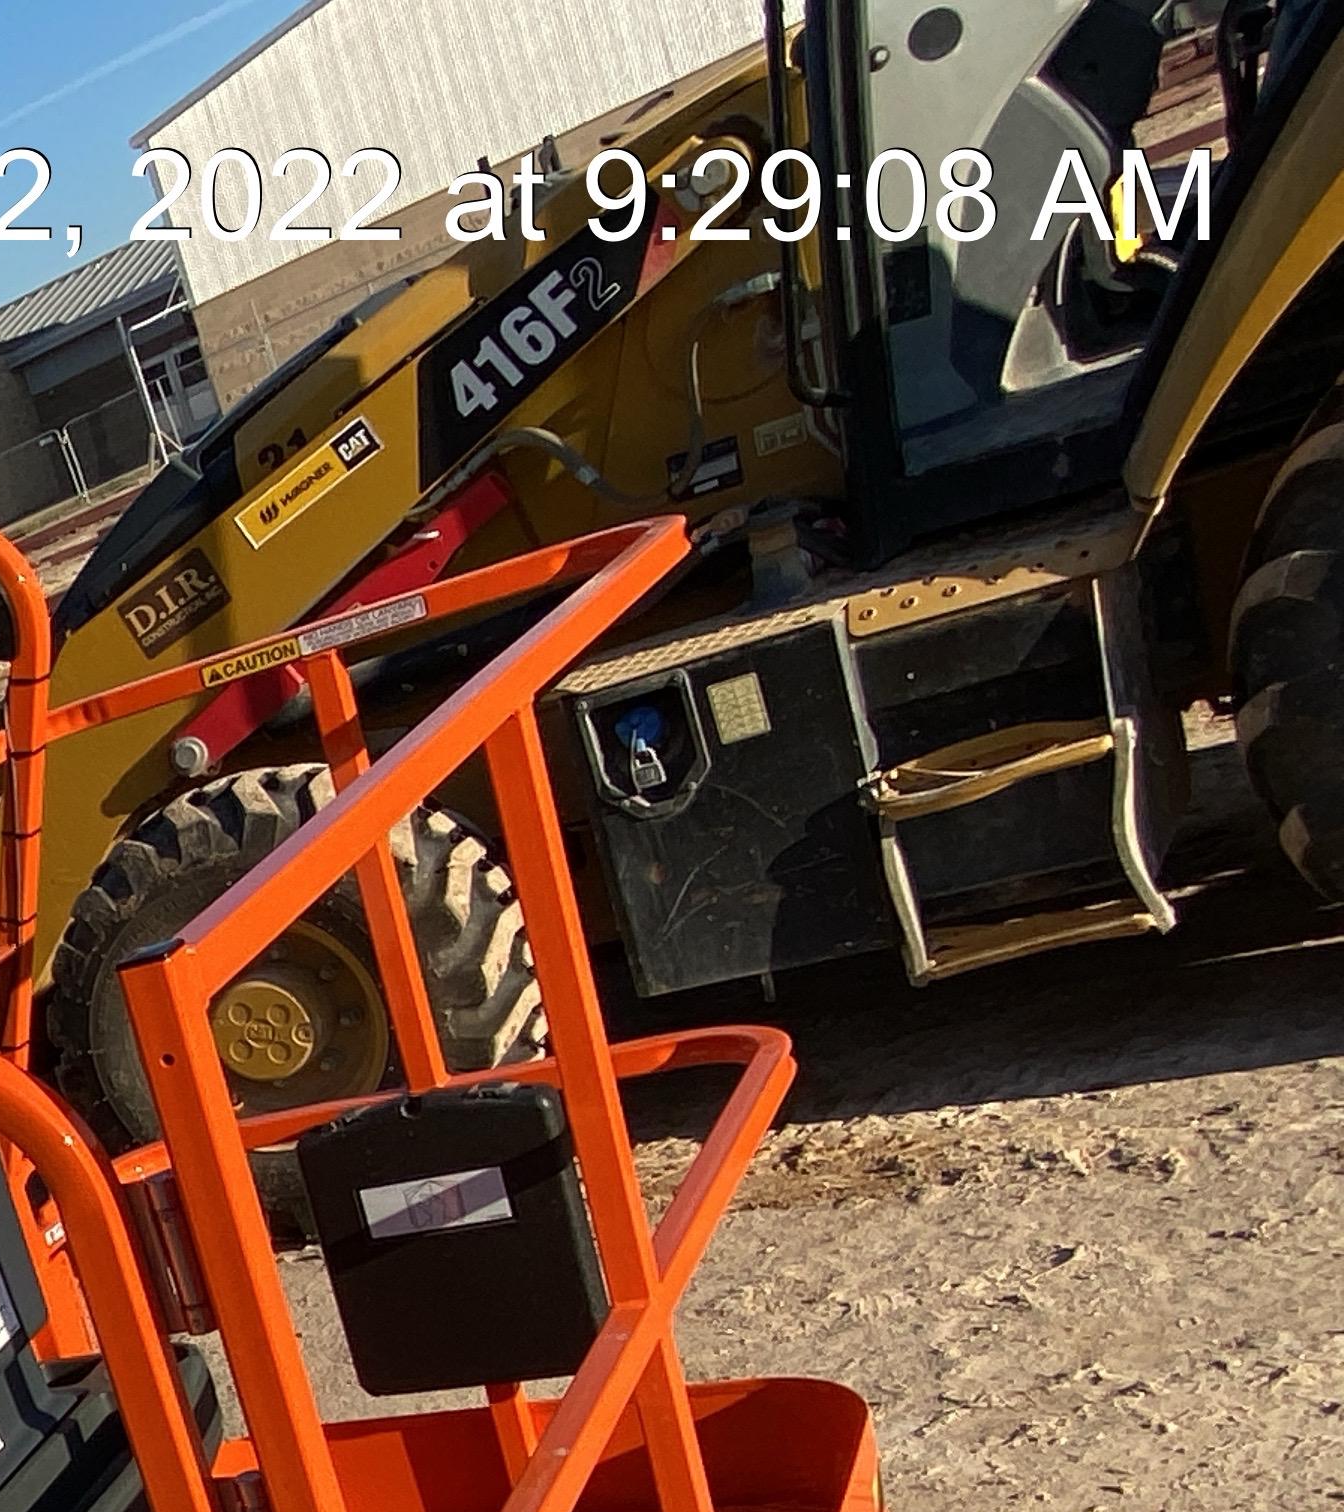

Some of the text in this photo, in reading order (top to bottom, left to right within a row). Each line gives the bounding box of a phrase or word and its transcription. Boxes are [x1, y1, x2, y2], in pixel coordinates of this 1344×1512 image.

[450, 256, 622, 418] 416F2
[338, 428, 371, 462] CAT
[124, 568, 216, 638] D.I.R.
[223, 640, 296, 677] CAUTION
